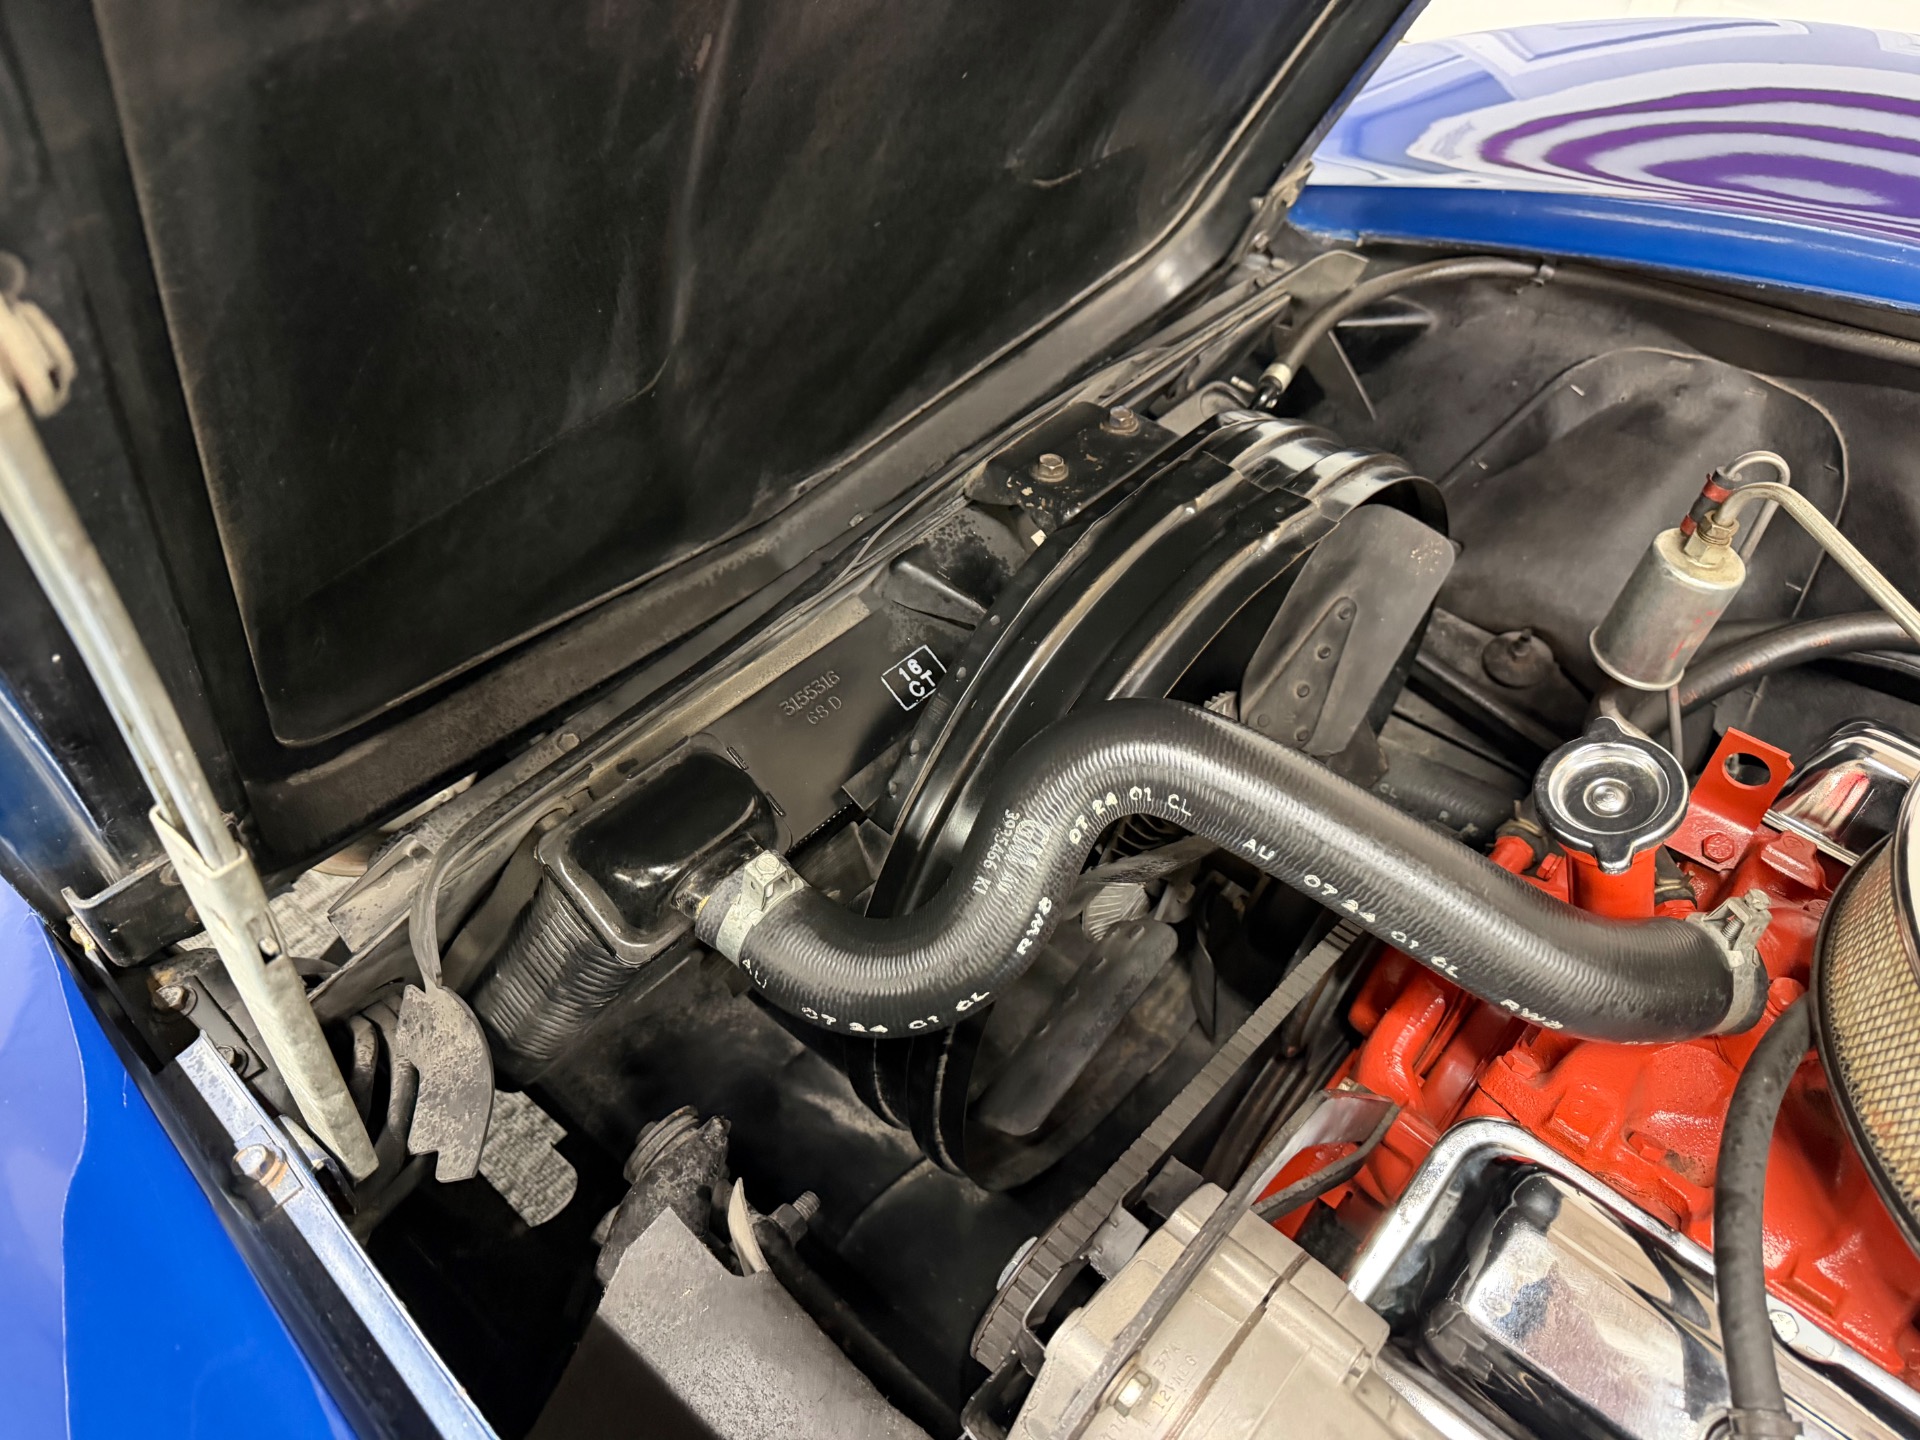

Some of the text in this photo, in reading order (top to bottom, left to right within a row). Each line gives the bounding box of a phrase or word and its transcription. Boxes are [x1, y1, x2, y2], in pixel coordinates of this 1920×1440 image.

[898, 658, 923, 682] 16
[908, 669, 936, 698] CT
[779, 670, 841, 716] 3155316
[828, 695, 842, 711] D
[1128, 785, 1152, 803] 01
[1167, 793, 1192, 817] CL
[1242, 838, 1275, 862] AU
[1303, 873, 1339, 897] 07
[1430, 955, 1459, 979] CL
